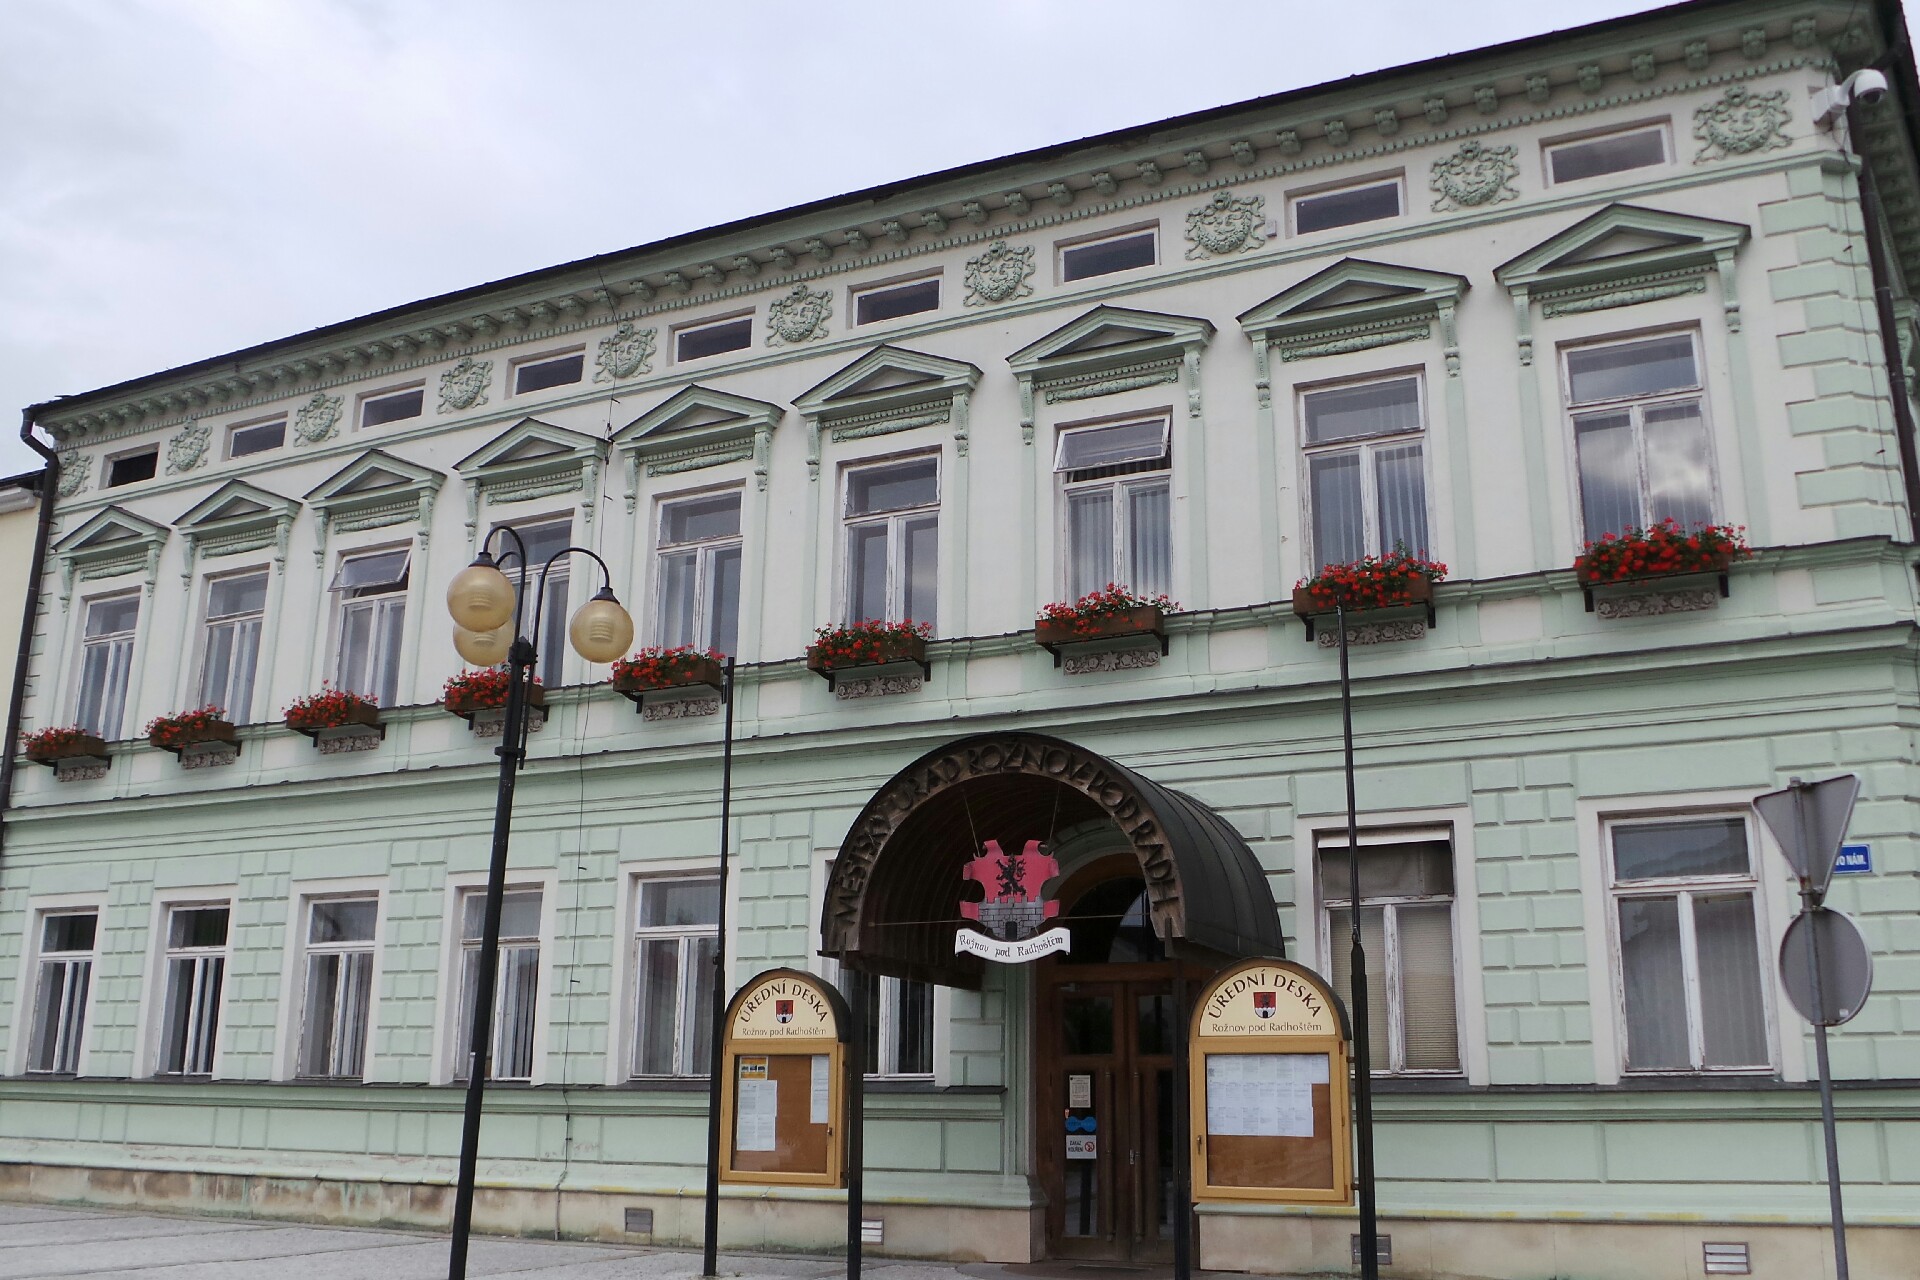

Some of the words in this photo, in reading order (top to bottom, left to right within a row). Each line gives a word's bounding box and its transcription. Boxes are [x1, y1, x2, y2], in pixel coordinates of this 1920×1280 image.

[966, 737, 1093, 780] ROŽNOV
[1086, 770, 1140, 820] POD
[958, 934, 990, 952] Rožnov
[994, 947, 1011, 957] pod
[1016, 935, 1064, 957] Radhoštěm
[739, 979, 787, 1024] ÚŘEDNÍ
[791, 984, 829, 1024] DESKA
[1207, 968, 1267, 1020] ÚŘEDNÍ
[1273, 973, 1322, 1019] DESKA
[742, 1027, 768, 1036] Rožnov
[769, 1026, 784, 1038] pod
[786, 1026, 827, 1036] Radhoštěm
[1211, 1022, 1246, 1033] Rožnov
[1248, 1022, 1267, 1034] pod
[1269, 1021, 1322, 1033] Radhoštěm
